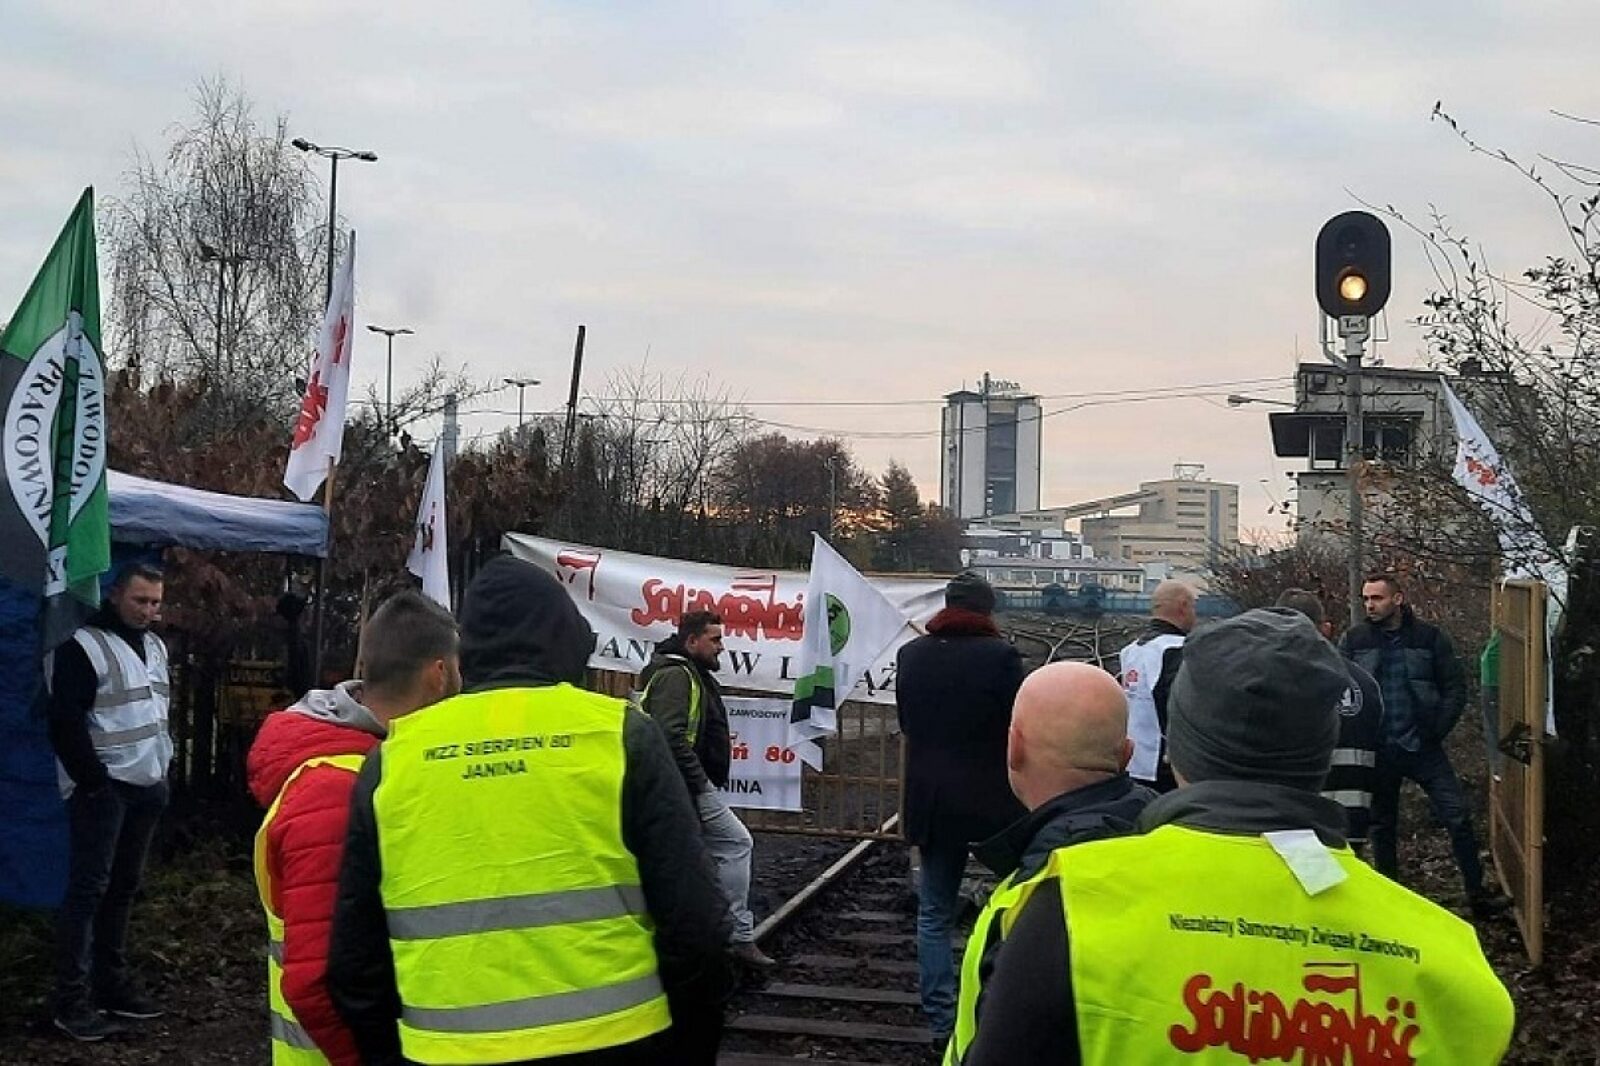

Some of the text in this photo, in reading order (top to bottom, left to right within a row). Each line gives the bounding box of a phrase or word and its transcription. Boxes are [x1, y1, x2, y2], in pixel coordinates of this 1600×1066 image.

[728, 649, 763, 675] W
[765, 746, 795, 764] 80
[462, 759, 528, 780] JANINA
[1170, 914, 1421, 964] Niezależny Samorządny Związek Zawodowy
